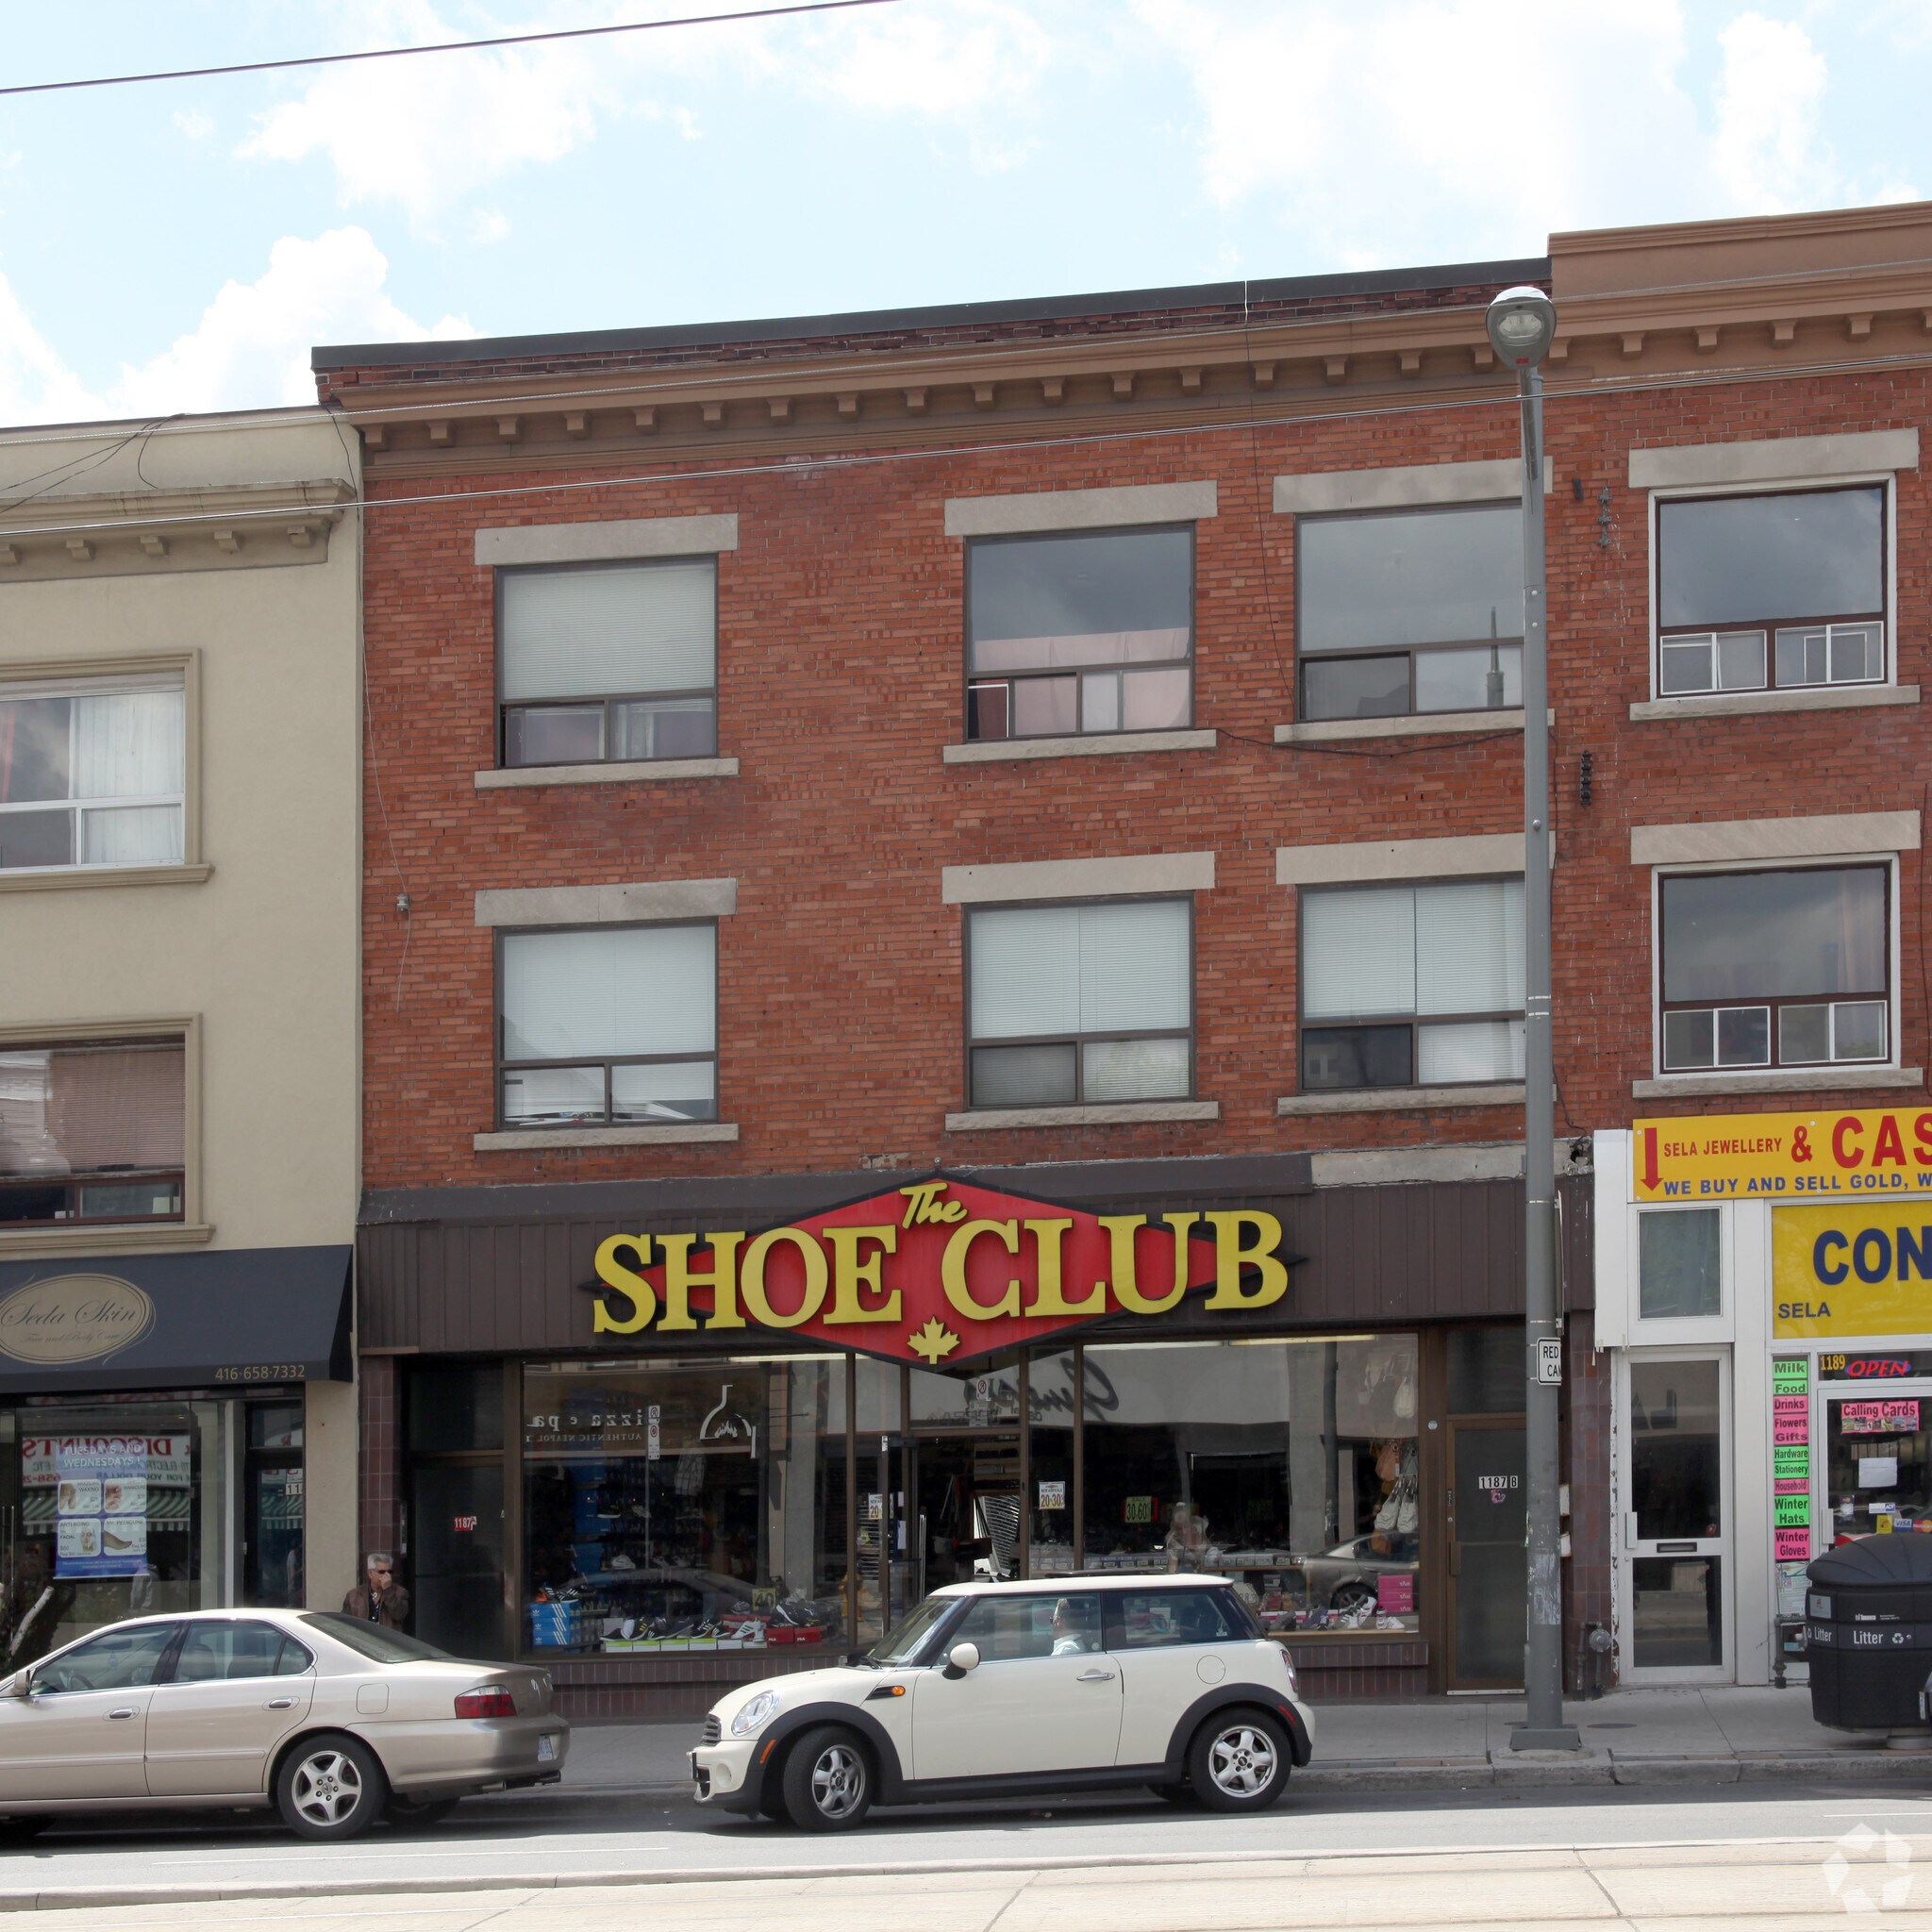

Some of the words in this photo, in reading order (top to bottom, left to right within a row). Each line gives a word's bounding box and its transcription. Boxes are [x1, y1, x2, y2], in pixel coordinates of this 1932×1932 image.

[1663, 1141, 1698, 1158] SELA
[1703, 1137, 1782, 1156] JEWELLERY
[1790, 1125, 1813, 1163] &
[1663, 1180, 1691, 1195] WE
[1700, 1178, 1739, 1193] BUY
[1746, 1176, 1786, 1192] AND
[1794, 1175, 1841, 1191] SELL
[1850, 1173, 1909, 1191] GOLD,
[899, 1181, 968, 1229] The
[593, 1224, 903, 1334] SHOE
[941, 1209, 1289, 1321] CLUB
[1777, 1302, 1831, 1319] SELA
[1542, 1345, 1559, 1358] RED
[1774, 1362, 1806, 1374] Milk
[1820, 1355, 1845, 1371] 1189
[1848, 1360, 1909, 1376] OPEN
[1774, 1383, 1806, 1394] Food
[1774, 1398, 1805, 1409] Drinks
[1843, 1404, 1879, 1418] Calling
[1881, 1402, 1916, 1416] Cards
[1774, 1417, 1807, 1429] Flowers
[1774, 1431, 1808, 1442] Gifts
[64, 1446, 117, 1456] TUESDAYS
[120, 1444, 141, 1453] AND
[1774, 1448, 1808, 1458] Hardware
[64, 1457, 133, 1468] WEDNESDAYS
[1774, 1464, 1808, 1475] Stationery
[1480, 1477, 1507, 1489] 1187
[1510, 1475, 1518, 1488] B
[1774, 1480, 1807, 1491] Household
[1774, 1498, 1808, 1509] Winter
[454, 1517, 472, 1528] 1187
[1779, 1512, 1806, 1524] Hats
[1775, 1531, 1809, 1542] Winter
[1779, 1544, 1807, 1557] Gloves
[1814, 1626, 1832, 1642] Litter
[1853, 1630, 1884, 1644] Litter
